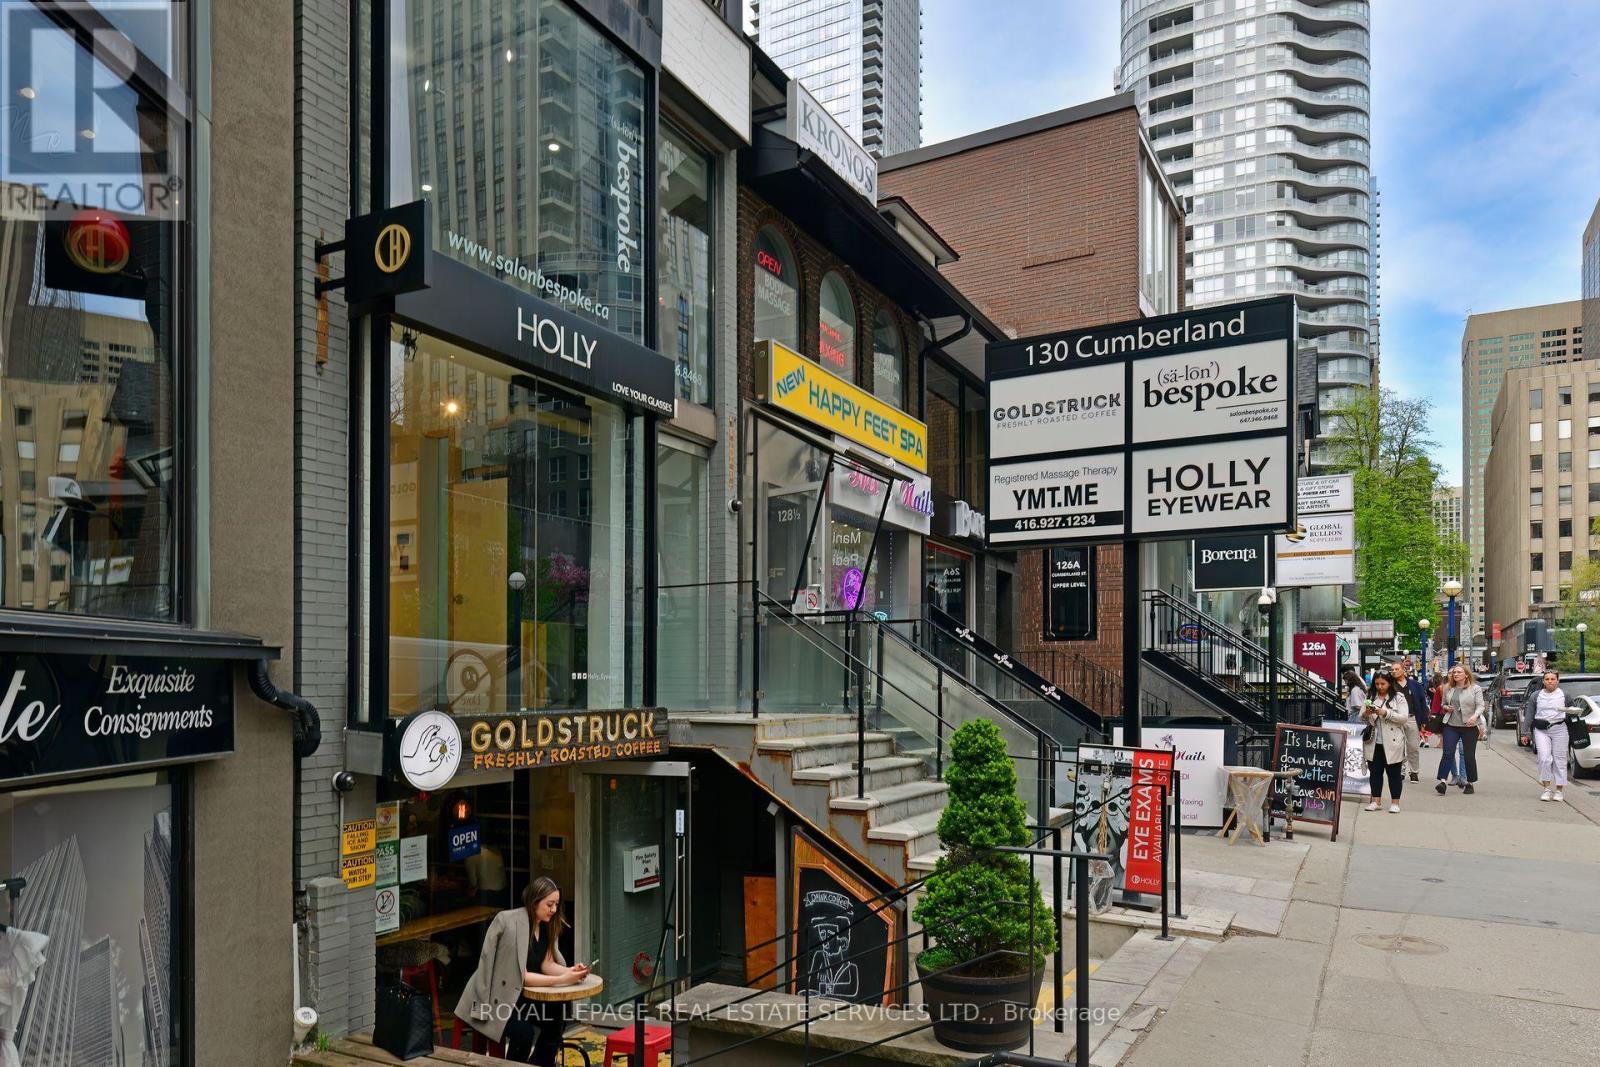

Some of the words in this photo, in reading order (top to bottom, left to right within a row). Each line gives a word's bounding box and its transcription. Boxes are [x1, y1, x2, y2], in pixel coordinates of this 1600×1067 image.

[801, 100, 873, 193] KRONOS
[611, 138, 638, 273] bespoke
[448, 230, 609, 320] www.salonbespoke.ca
[757, 251, 782, 276] OPEN
[764, 272, 785, 296] BODY
[757, 285, 791, 316] MASSAGE
[517, 306, 598, 369] HOLLY
[1025, 340, 1069, 367] 130
[1075, 311, 1246, 359] Cumberland
[612, 381, 629, 396] LOVE
[629, 388, 648, 404] YOUR
[647, 396, 673, 413] GLASSES
[1142, 365, 1279, 412] bespoke
[776, 364, 806, 399] NEW
[809, 380, 861, 428] HAPPY
[864, 409, 898, 445] FEET
[900, 425, 924, 459] SPA
[993, 392, 1122, 422] GOLDSTRUCK
[996, 418, 1034, 430] FRESHLY
[1036, 413, 1078, 425] ROASTED
[1081, 408, 1117, 421] COFFEE
[993, 470, 1039, 486] Registered
[1040, 466, 1080, 484] Massage
[1082, 463, 1118, 480] Therapy
[1147, 457, 1271, 494] HOLLY
[1012, 482, 1099, 512] YMT.ME
[1147, 490, 1271, 517] EYEWEAR
[1014, 514, 1096, 531] 416.927.1234
[1309, 523, 1343, 531] GLOBAL
[1056, 561, 1081, 570] 126A
[1200, 547, 1258, 565] Borenta
[1302, 642, 1326, 651] 126A
[105, 665, 196, 699] Exquisite
[84, 704, 213, 739] Consignments
[470, 711, 655, 753] GOLDSTRUCK
[1284, 730, 1301, 747] It's
[1306, 734, 1333, 751] better
[473, 750, 543, 770] FRESHLY
[550, 744, 611, 764] ROASTED
[616, 740, 661, 757] COFFEE
[1175, 751, 1207, 761] Nails
[1307, 754, 1333, 768] where
[1135, 758, 1155, 823] EXAMS
[343, 821, 375, 832] CAUTION
[452, 830, 478, 847] OPEN
[376, 845, 395, 857] PASS
[1133, 826, 1150, 861] EYE
[343, 856, 375, 868] CAUTION
[348, 868, 367, 877] WATCH
[1140, 877, 1160, 886] HOLLY
